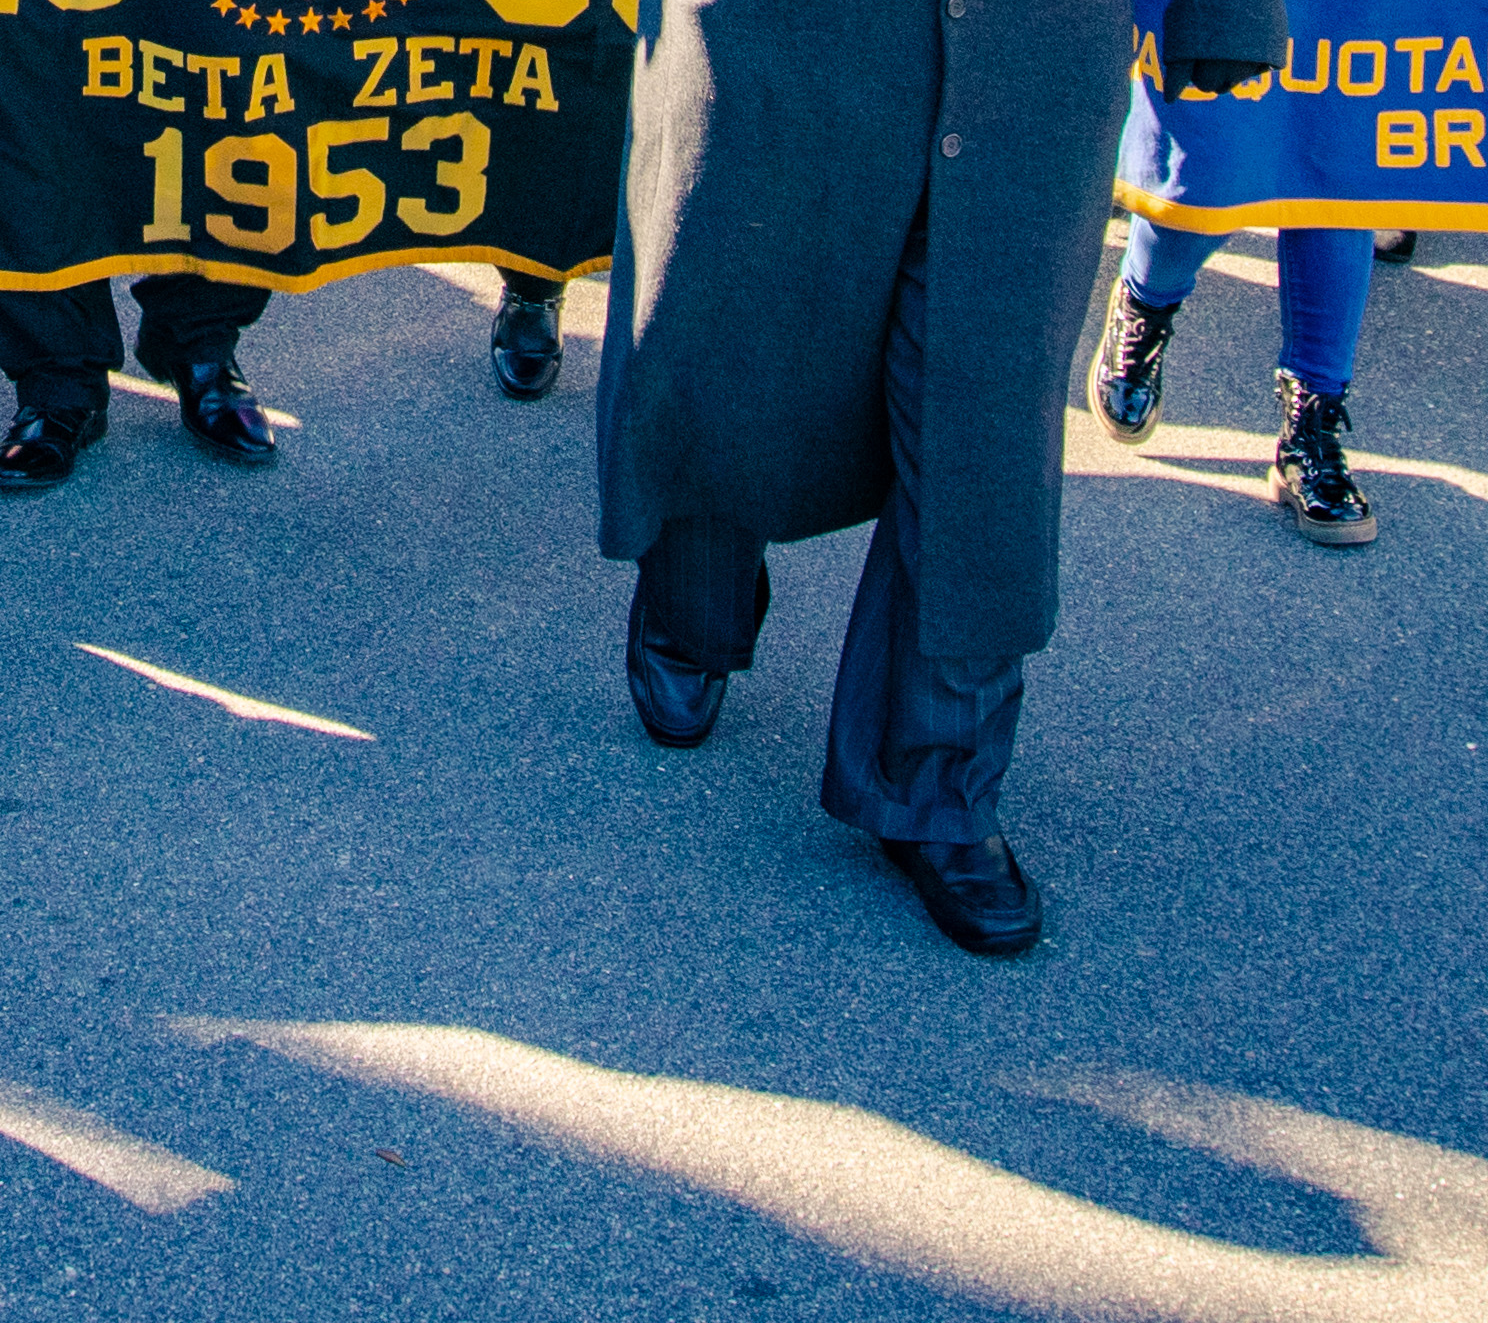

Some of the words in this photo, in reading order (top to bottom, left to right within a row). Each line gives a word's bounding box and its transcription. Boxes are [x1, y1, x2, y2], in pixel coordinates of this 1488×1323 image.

[83, 36, 296, 122] BETA
[352, 36, 560, 112] ZETA
[142, 112, 492, 255] 1953
